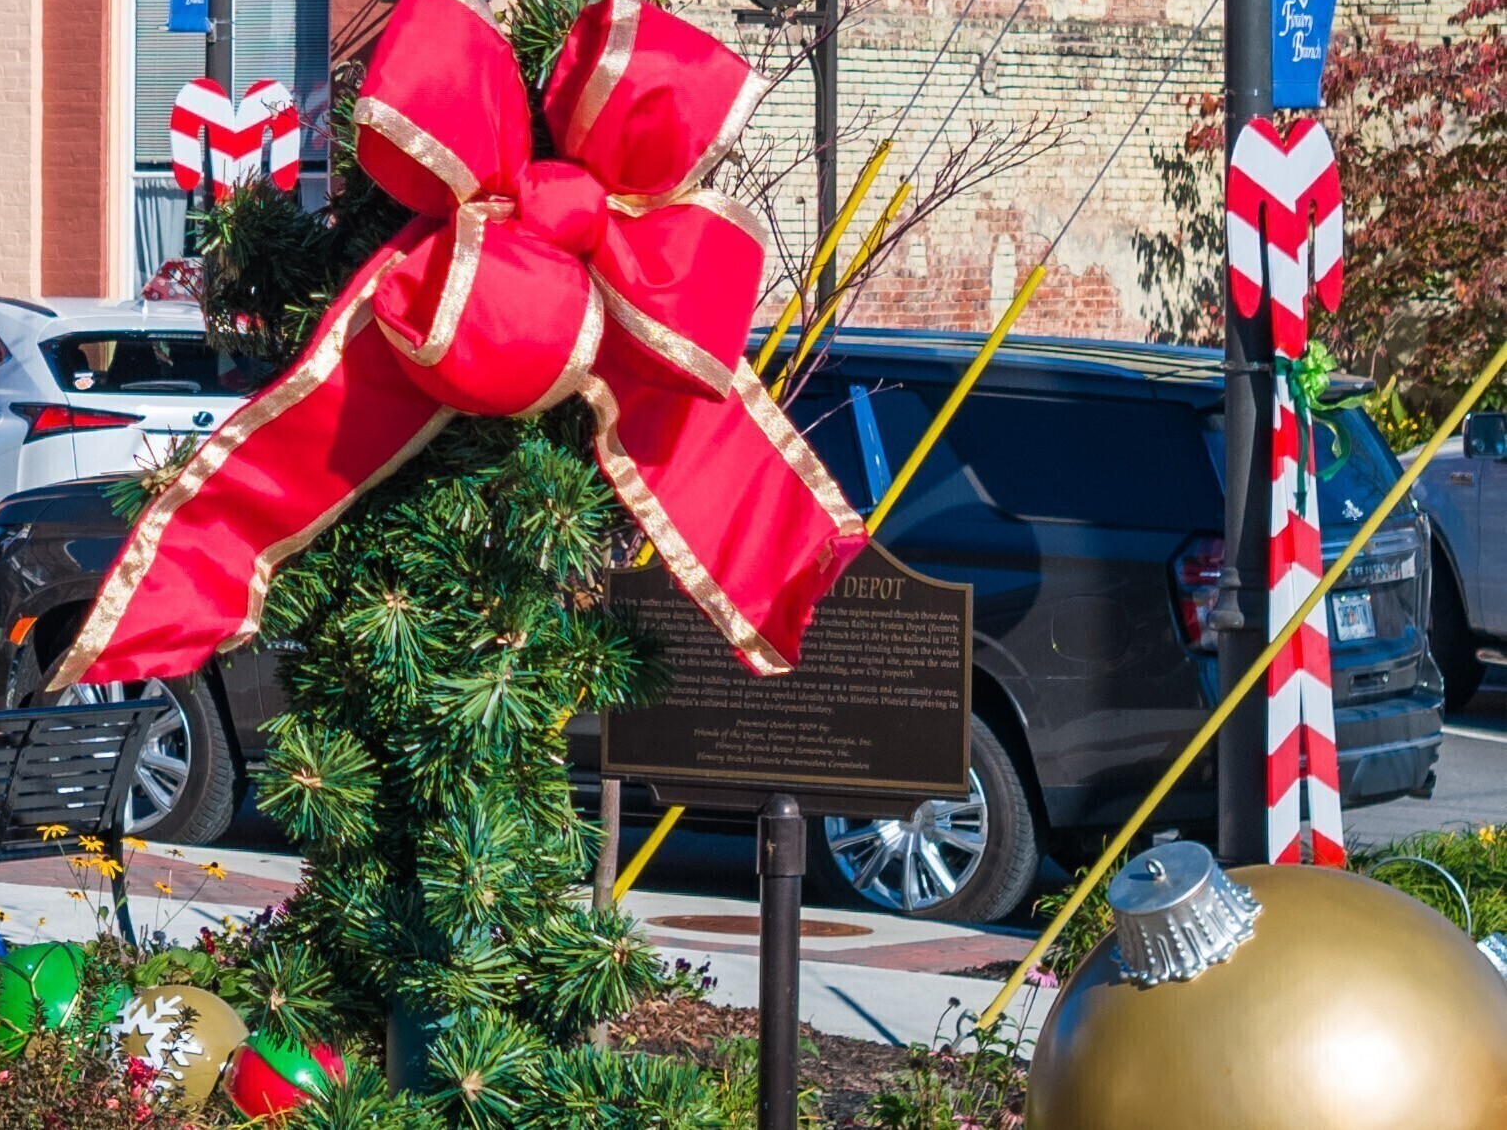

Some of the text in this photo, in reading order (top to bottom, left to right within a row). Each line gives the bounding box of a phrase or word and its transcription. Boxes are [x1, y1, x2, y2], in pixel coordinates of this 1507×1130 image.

[843, 575, 906, 601] DEPOT
[820, 606, 836, 616] from
[848, 607, 869, 619] region
[893, 609, 919, 621] through
[819, 618, 849, 627] Southern
[850, 619, 877, 631] Railway
[879, 620, 903, 632] System
[905, 621, 925, 633] Depot
[825, 629, 849, 639] Branch
[902, 633, 931, 643] Railroad
[892, 644, 918, 656] through
[828, 653, 845, 663] from
[857, 655, 884, 666] original
[729, 687, 742, 697] and
[798, 691, 824, 703] identity
[849, 695, 878, 705] Historic
[880, 696, 908, 707] District
[878, 685, 892, 694] and
[893, 686, 932, 697] community
[728, 699, 741, 708] and
[693, 727, 718, 736] Friends
[767, 731, 795, 743] Flowery
[715, 741, 743, 752] Flowery
[744, 743, 770, 752] Branch
[696, 751, 724, 764] Flowery
[726, 753, 751, 763] Branch
